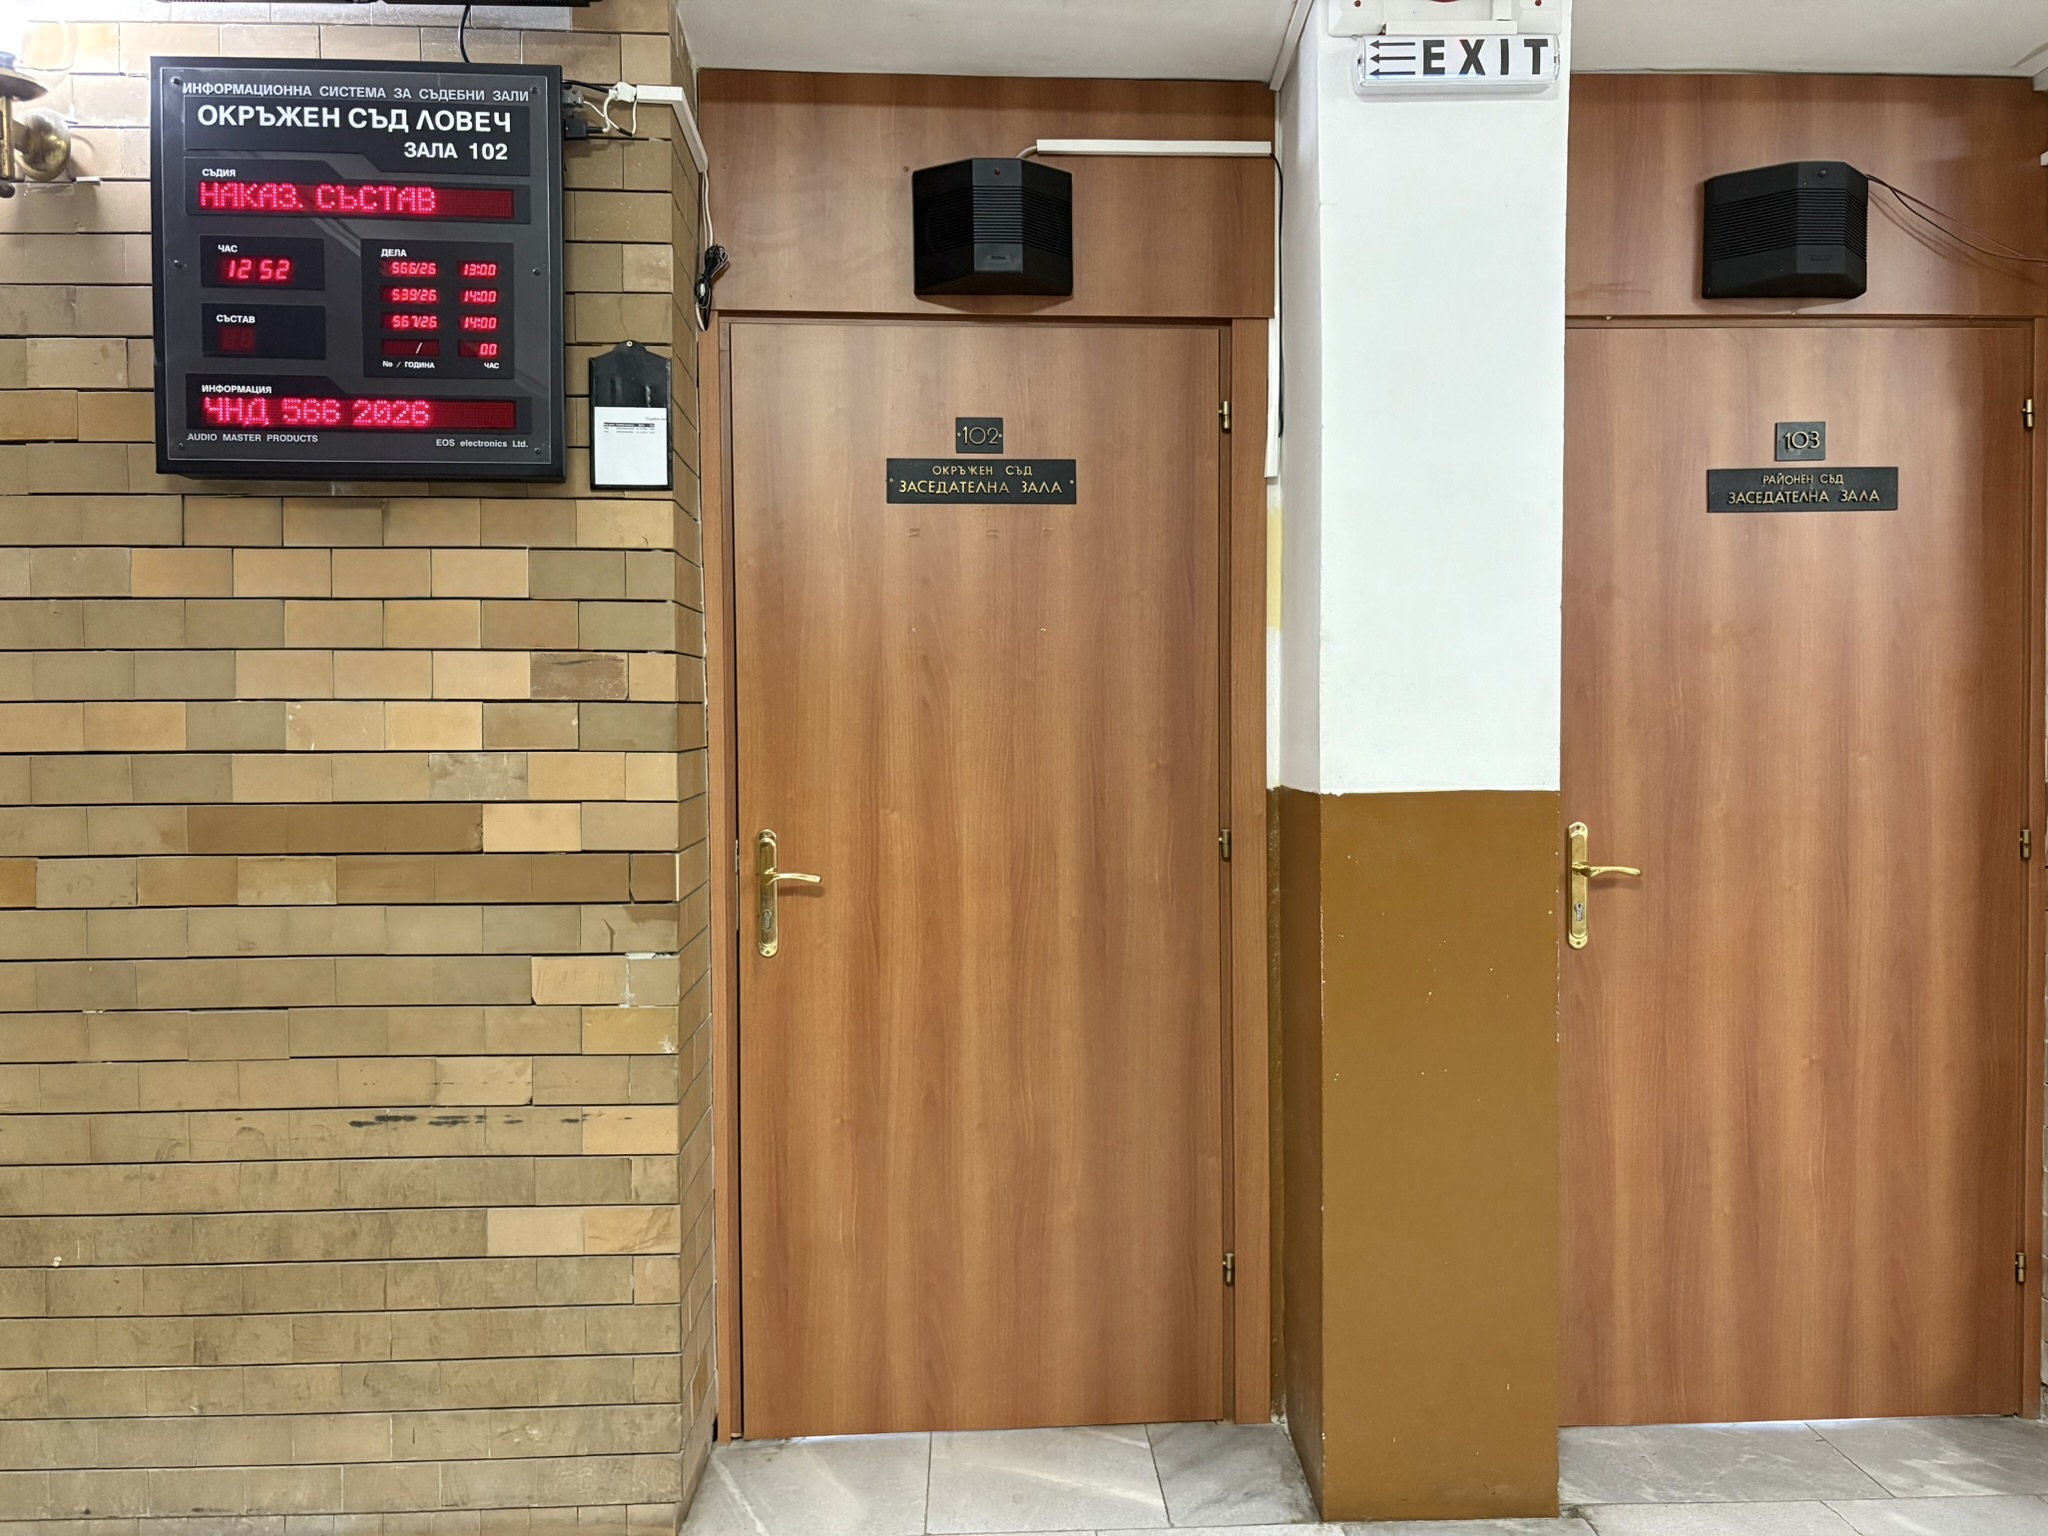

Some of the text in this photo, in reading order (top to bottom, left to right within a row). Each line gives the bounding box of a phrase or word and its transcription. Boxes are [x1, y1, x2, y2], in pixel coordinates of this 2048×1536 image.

[1422, 38, 1549, 76] EXIT
[182, 82, 529, 102] ИНФОРМАЦИОННА СИСТЕМА ЗА СЪДЕБНИ ЗАЛИ
[197, 104, 511, 133] ОКРЪЖЕН СЪД ЛОВЕЧ
[403, 142, 508, 160] ЗАЛА 102
[202, 168, 236, 178] СЪДИЯ
[200, 181, 436, 212] НАКАЗ. СЪСТАВ
[218, 244, 238, 253] ЧАС
[380, 248, 407, 258] ДЕЛА
[228, 258, 290, 280] 12 52
[391, 261, 437, 275] 566/26
[463, 263, 497, 276] 13:00
[391, 288, 437, 302] 539/26
[463, 290, 497, 303] 14:00
[216, 314, 256, 324] СЪСТАВ
[391, 315, 438, 329] 567/26
[463, 316, 497, 329] 14:00
[404, 362, 436, 370] ГОДИНА
[483, 362, 500, 370] ЧАС
[201, 384, 272, 395] ИНФОРМАЦИЯ
[204, 396, 430, 427] ЧНД 566 2026
[188, 433, 319, 443] AUDIO MASTER PRODUCTS
[962, 426, 999, 445] 102
[1785, 430, 1821, 449] 103
[435, 438, 529, 448] EOS electronics Ltd.
[932, 465, 1033, 476] ОКРЪЖЕН СЪД
[1762, 472, 1845, 485] РАЙОНЕН СЪД
[899, 480, 1063, 494] ЗАСЕДАТЕЛНА ЗАЛА
[1727, 489, 1880, 505] ЗАСЕДАТЕЛНА ЗАЛА
